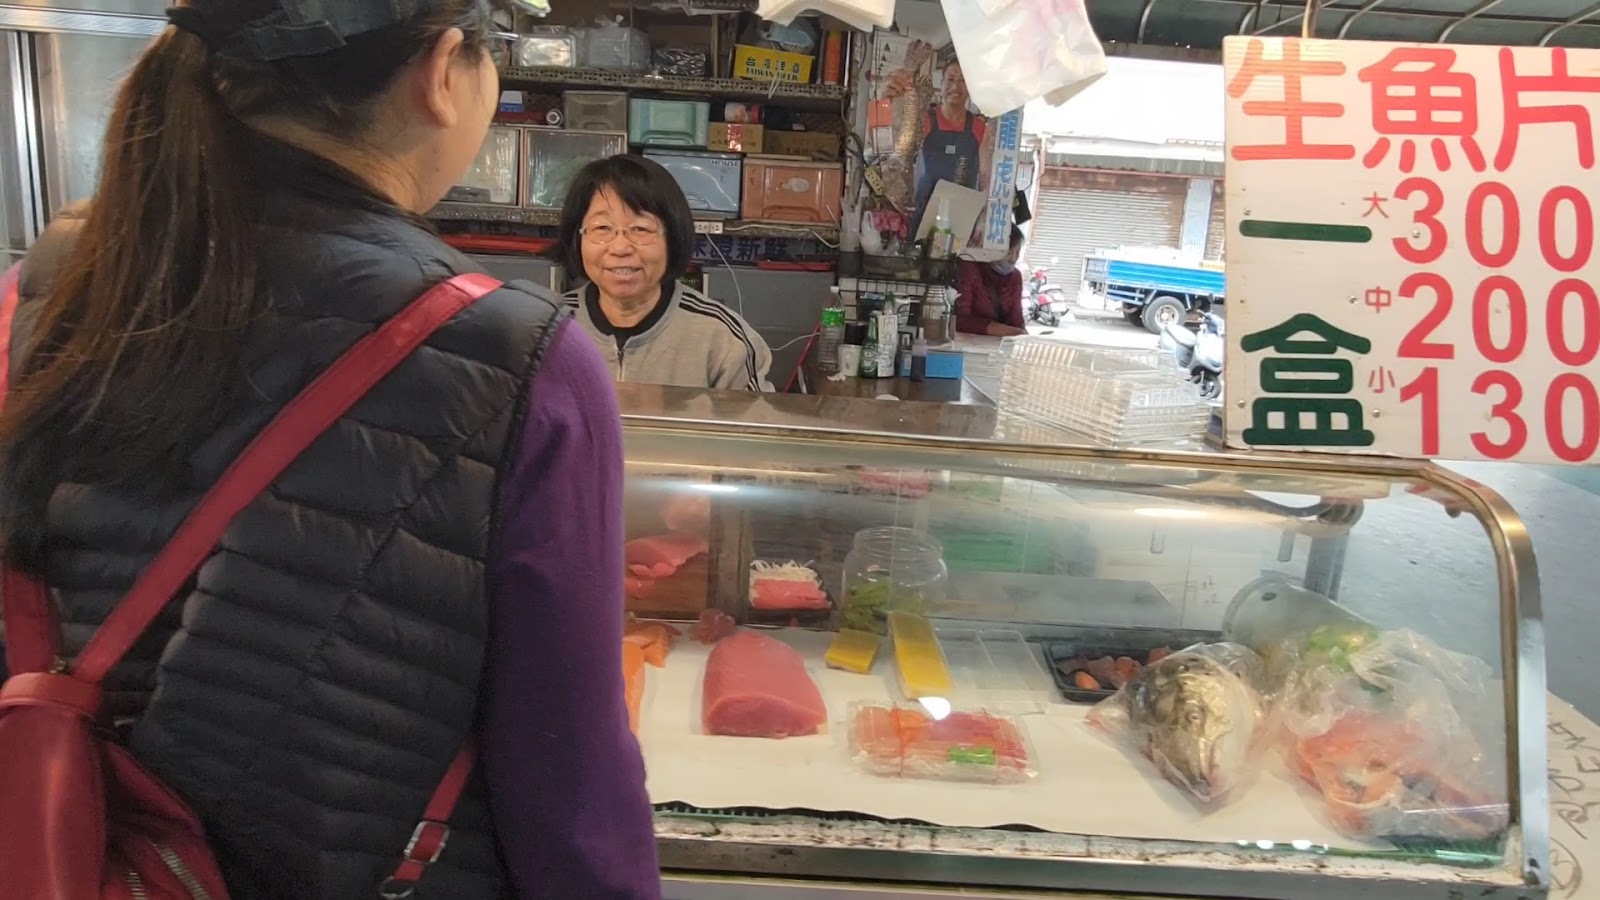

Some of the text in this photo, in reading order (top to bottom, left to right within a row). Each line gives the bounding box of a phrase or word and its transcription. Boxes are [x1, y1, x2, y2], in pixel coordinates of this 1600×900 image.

[1228, 36, 1600, 172] 生魚片
[1362, 176, 1594, 272] 大 300
[1239, 219, 1375, 447] 一盒
[1364, 271, 1600, 367] 中 200
[1368, 365, 1600, 463] 小 130
